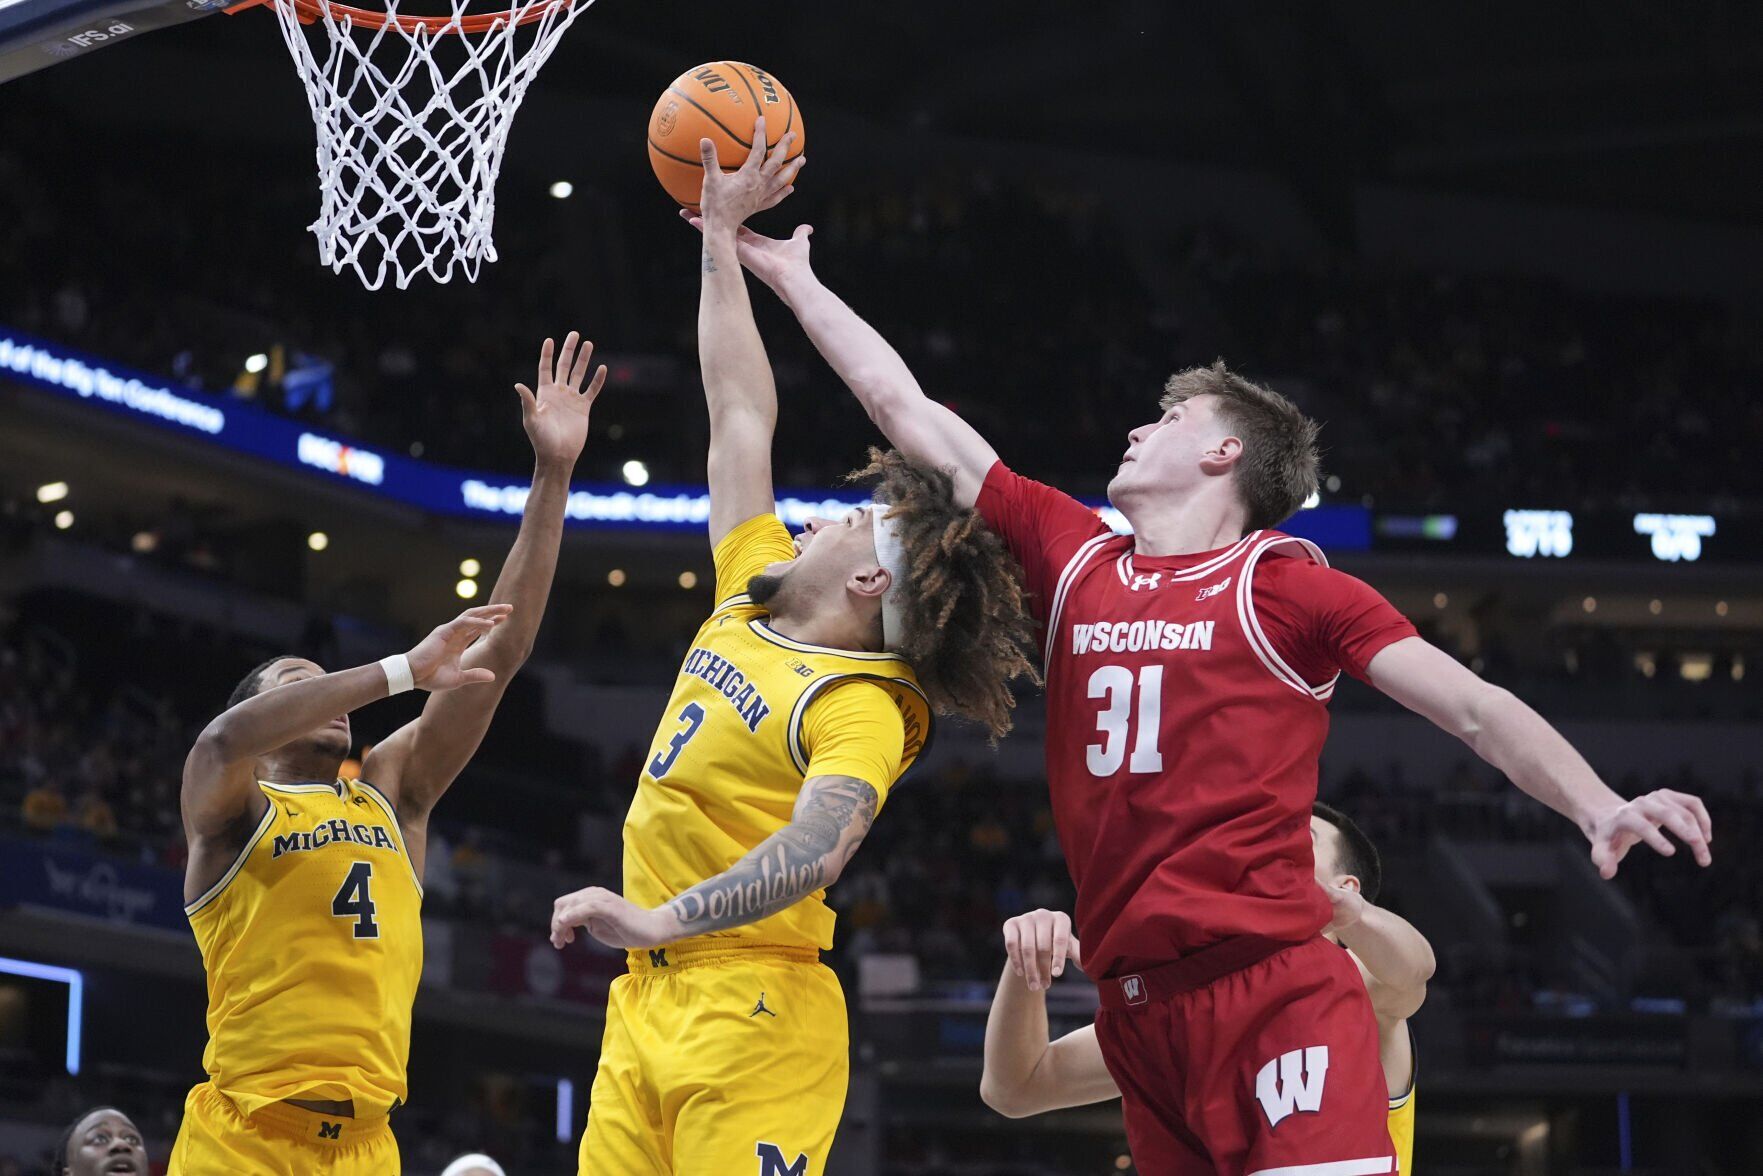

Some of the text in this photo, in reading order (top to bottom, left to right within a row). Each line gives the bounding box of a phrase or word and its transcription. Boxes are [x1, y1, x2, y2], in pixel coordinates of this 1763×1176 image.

[67, 21, 135, 48] IFS.ai
[1072, 620, 1215, 655] WSCONSIN
[1086, 664, 1164, 777] 31
[648, 702, 706, 780] 3
[272, 819, 400, 859] MICHGA
[331, 861, 379, 940] 4
[648, 948, 669, 968] M
[1123, 977, 1139, 1000] W
[1256, 1045, 1329, 1128] W
[318, 1121, 342, 1139] M
[755, 1140, 809, 1176] M
